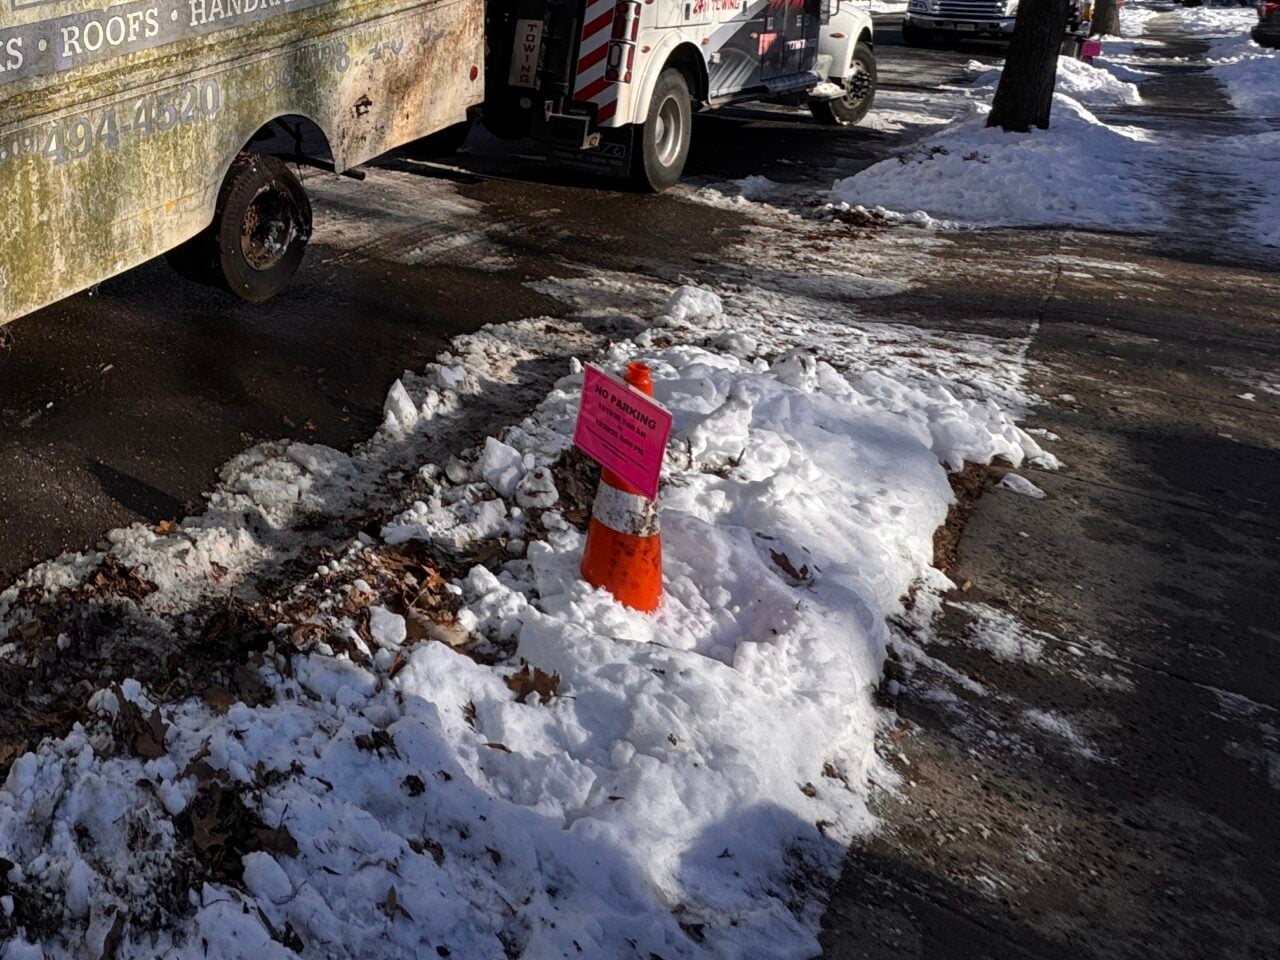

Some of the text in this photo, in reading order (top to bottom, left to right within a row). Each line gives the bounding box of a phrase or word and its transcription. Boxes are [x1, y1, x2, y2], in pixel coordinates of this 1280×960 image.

[60, 7, 160, 58] ROOFS
[520, 23, 538, 83] TOWING
[44, 79, 222, 168] 494-4520
[595, 383, 657, 430] NO PARKING
